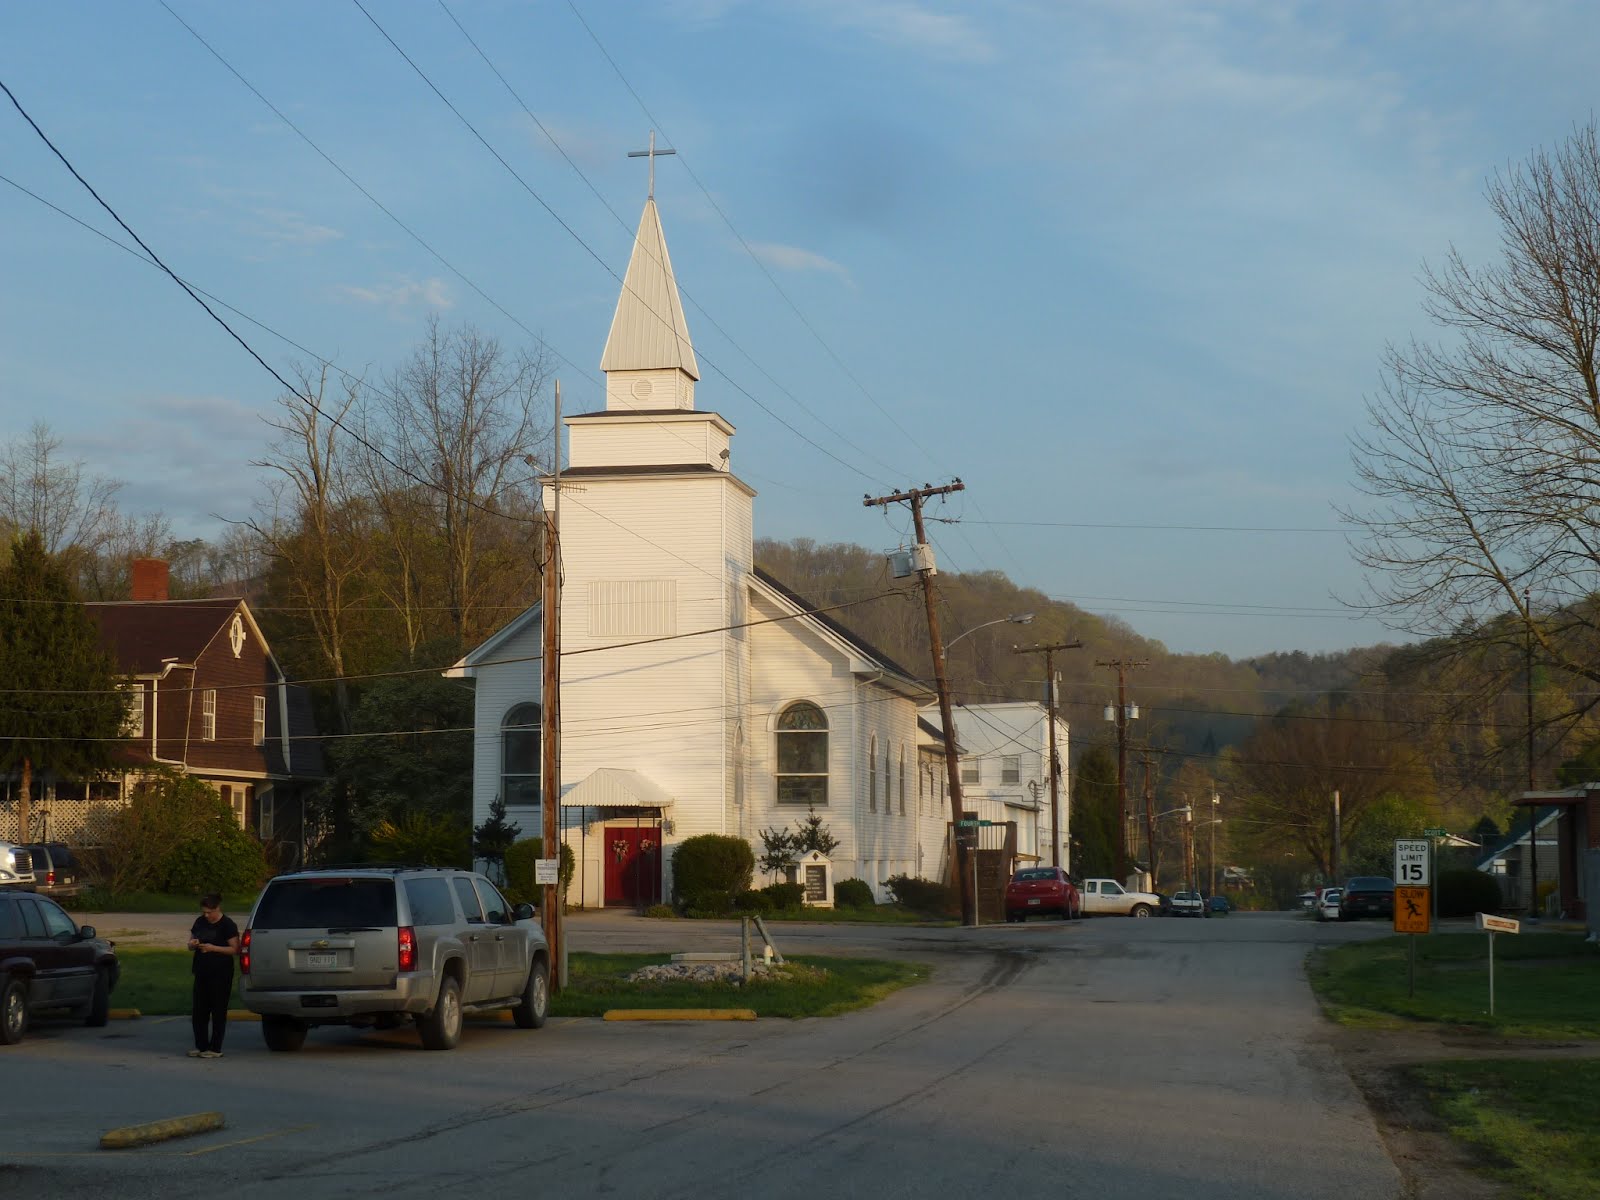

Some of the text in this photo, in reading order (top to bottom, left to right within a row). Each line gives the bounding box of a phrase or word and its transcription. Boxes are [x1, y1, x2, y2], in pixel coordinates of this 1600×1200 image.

[1398, 844, 1427, 852] SPEED
[1400, 854, 1424, 862] LIMIT
[1401, 864, 1423, 881] 15
[1400, 889, 1425, 900] SLOW
